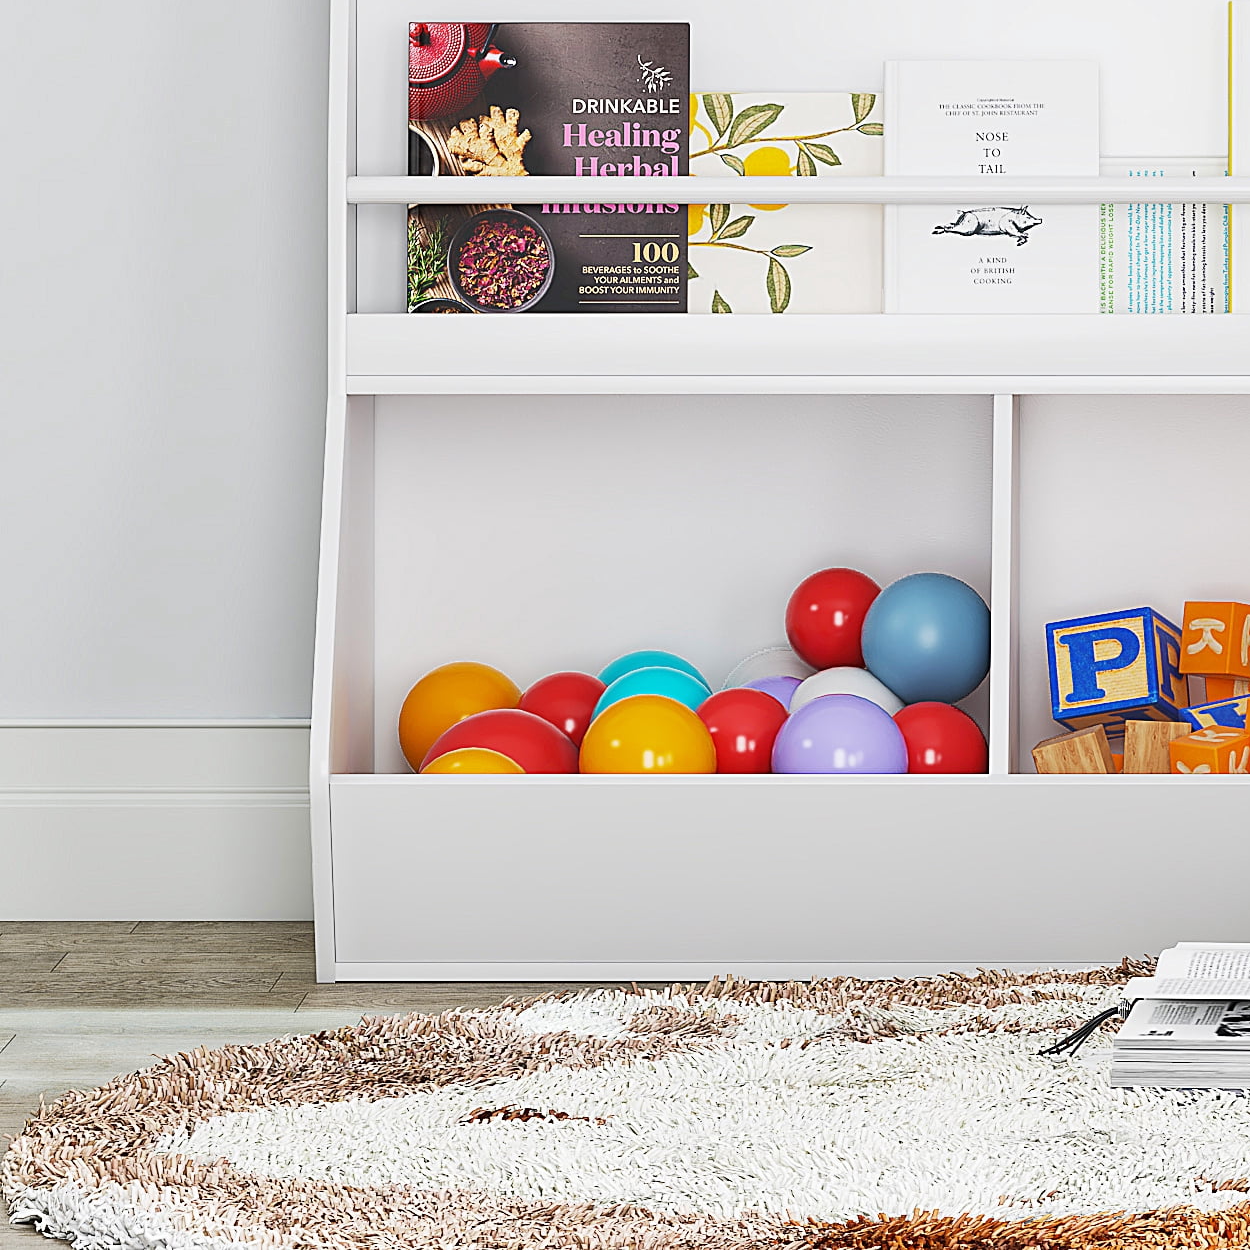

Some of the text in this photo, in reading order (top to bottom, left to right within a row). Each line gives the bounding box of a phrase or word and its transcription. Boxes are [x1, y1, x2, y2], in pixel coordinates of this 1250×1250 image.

[572, 98, 680, 114] DRINKABLE
[562, 121, 682, 154] Healing
[975, 131, 1008, 142] NOSE
[982, 148, 1001, 157] TO
[574, 155, 679, 176] Herbal
[978, 164, 1006, 174] TAIL
[632, 241, 680, 263] 100
[582, 266, 679, 274] BEVERAGES to SOOTHE
[594, 276, 679, 284] YOUR AILMENTS and
[578, 286, 680, 294] BOOST YOUR IMMUNITY
[1058, 626, 1140, 704] P
